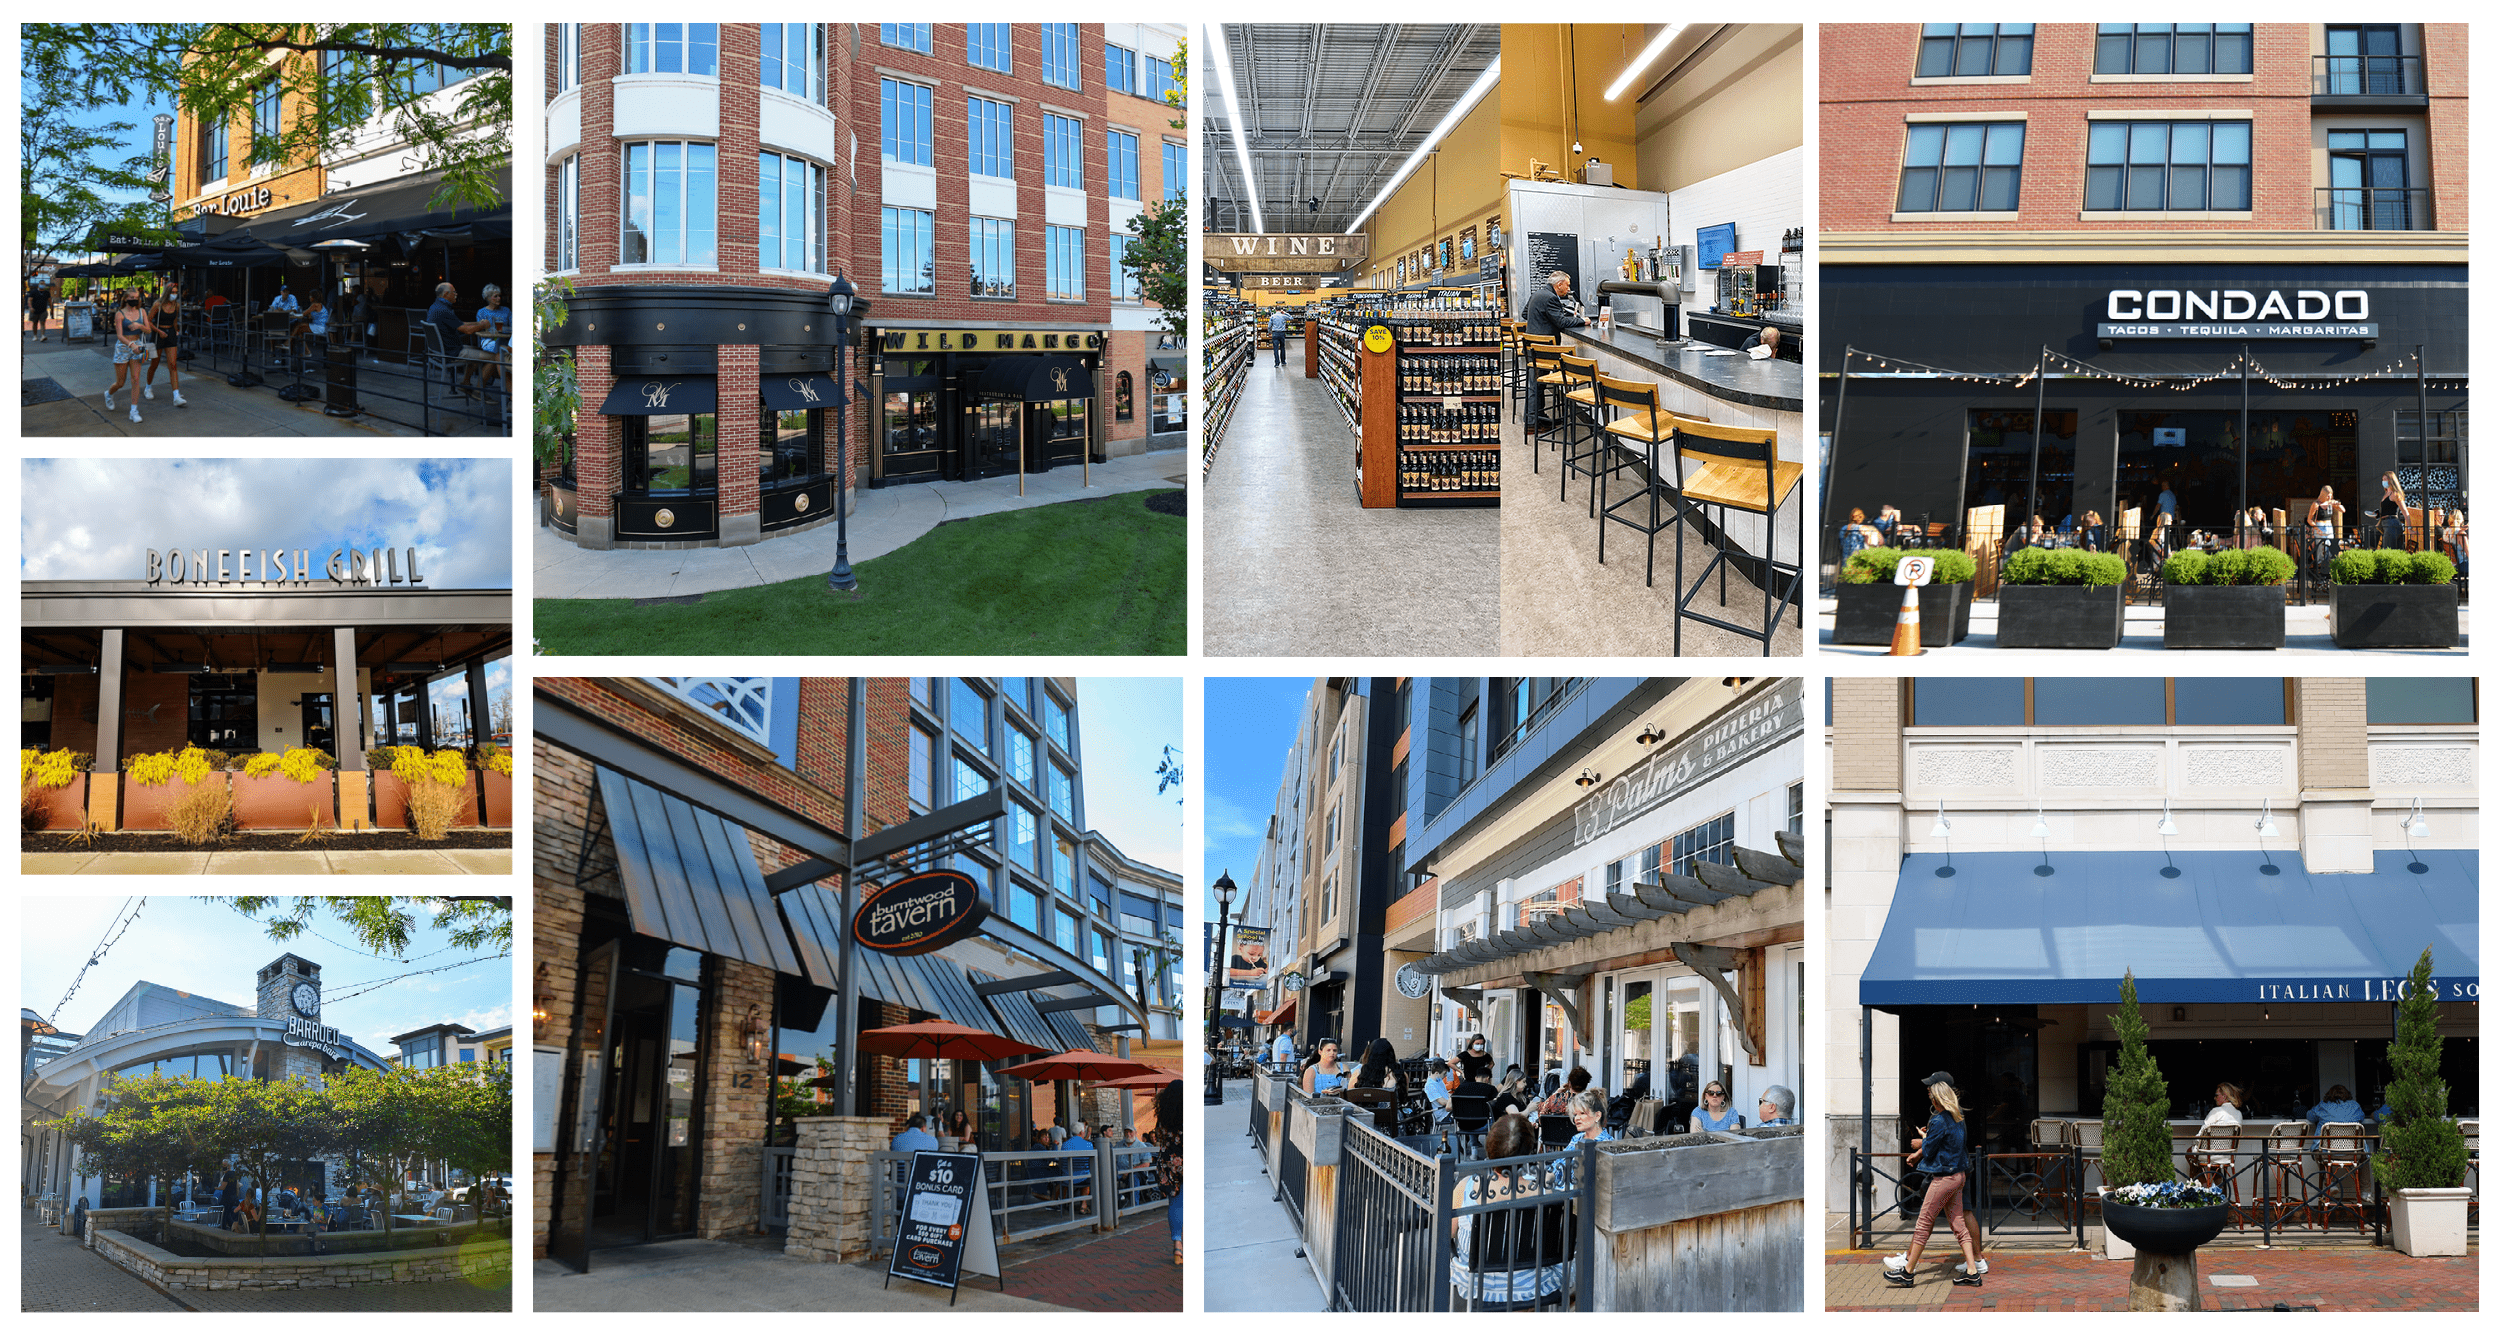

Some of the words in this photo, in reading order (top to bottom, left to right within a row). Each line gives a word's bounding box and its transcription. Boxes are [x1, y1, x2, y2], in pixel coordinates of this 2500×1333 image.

[221, 185, 272, 215] Louie
[1230, 236, 1335, 255] WINE
[1261, 277, 1303, 286] BEER
[2107, 290, 2369, 320] CONDADO
[2108, 326, 2159, 335] TACOS
[2180, 326, 2247, 336] TEQUILA
[2269, 326, 2369, 335] MARGARITAS
[885, 332, 978, 349] WILD
[998, 333, 1101, 349] MANGO
[146, 548, 310, 584] BONEFISH
[326, 547, 424, 584] GRILL
[1703, 694, 1784, 751] PIZZERIA
[1703, 755, 1713, 768] &
[1716, 712, 1785, 764] BAKERY
[1603, 751, 1696, 834] Palms
[876, 881, 955, 917] burntwood
[869, 897, 956, 937] tavern
[2259, 984, 2350, 999] ITALIAN
[288, 1015, 340, 1046] BARROCO
[300, 1040, 322, 1050] arepa
[322, 1043, 337, 1058] bar
[732, 1073, 753, 1088] 12
[929, 1169, 954, 1184] $10
[915, 1182, 941, 1192] BONUS
[942, 1185, 964, 1195] CARD
[928, 1226, 948, 1235] EVERY
[906, 1234, 922, 1242] CARD
[922, 1237, 954, 1248] PURCHASE
